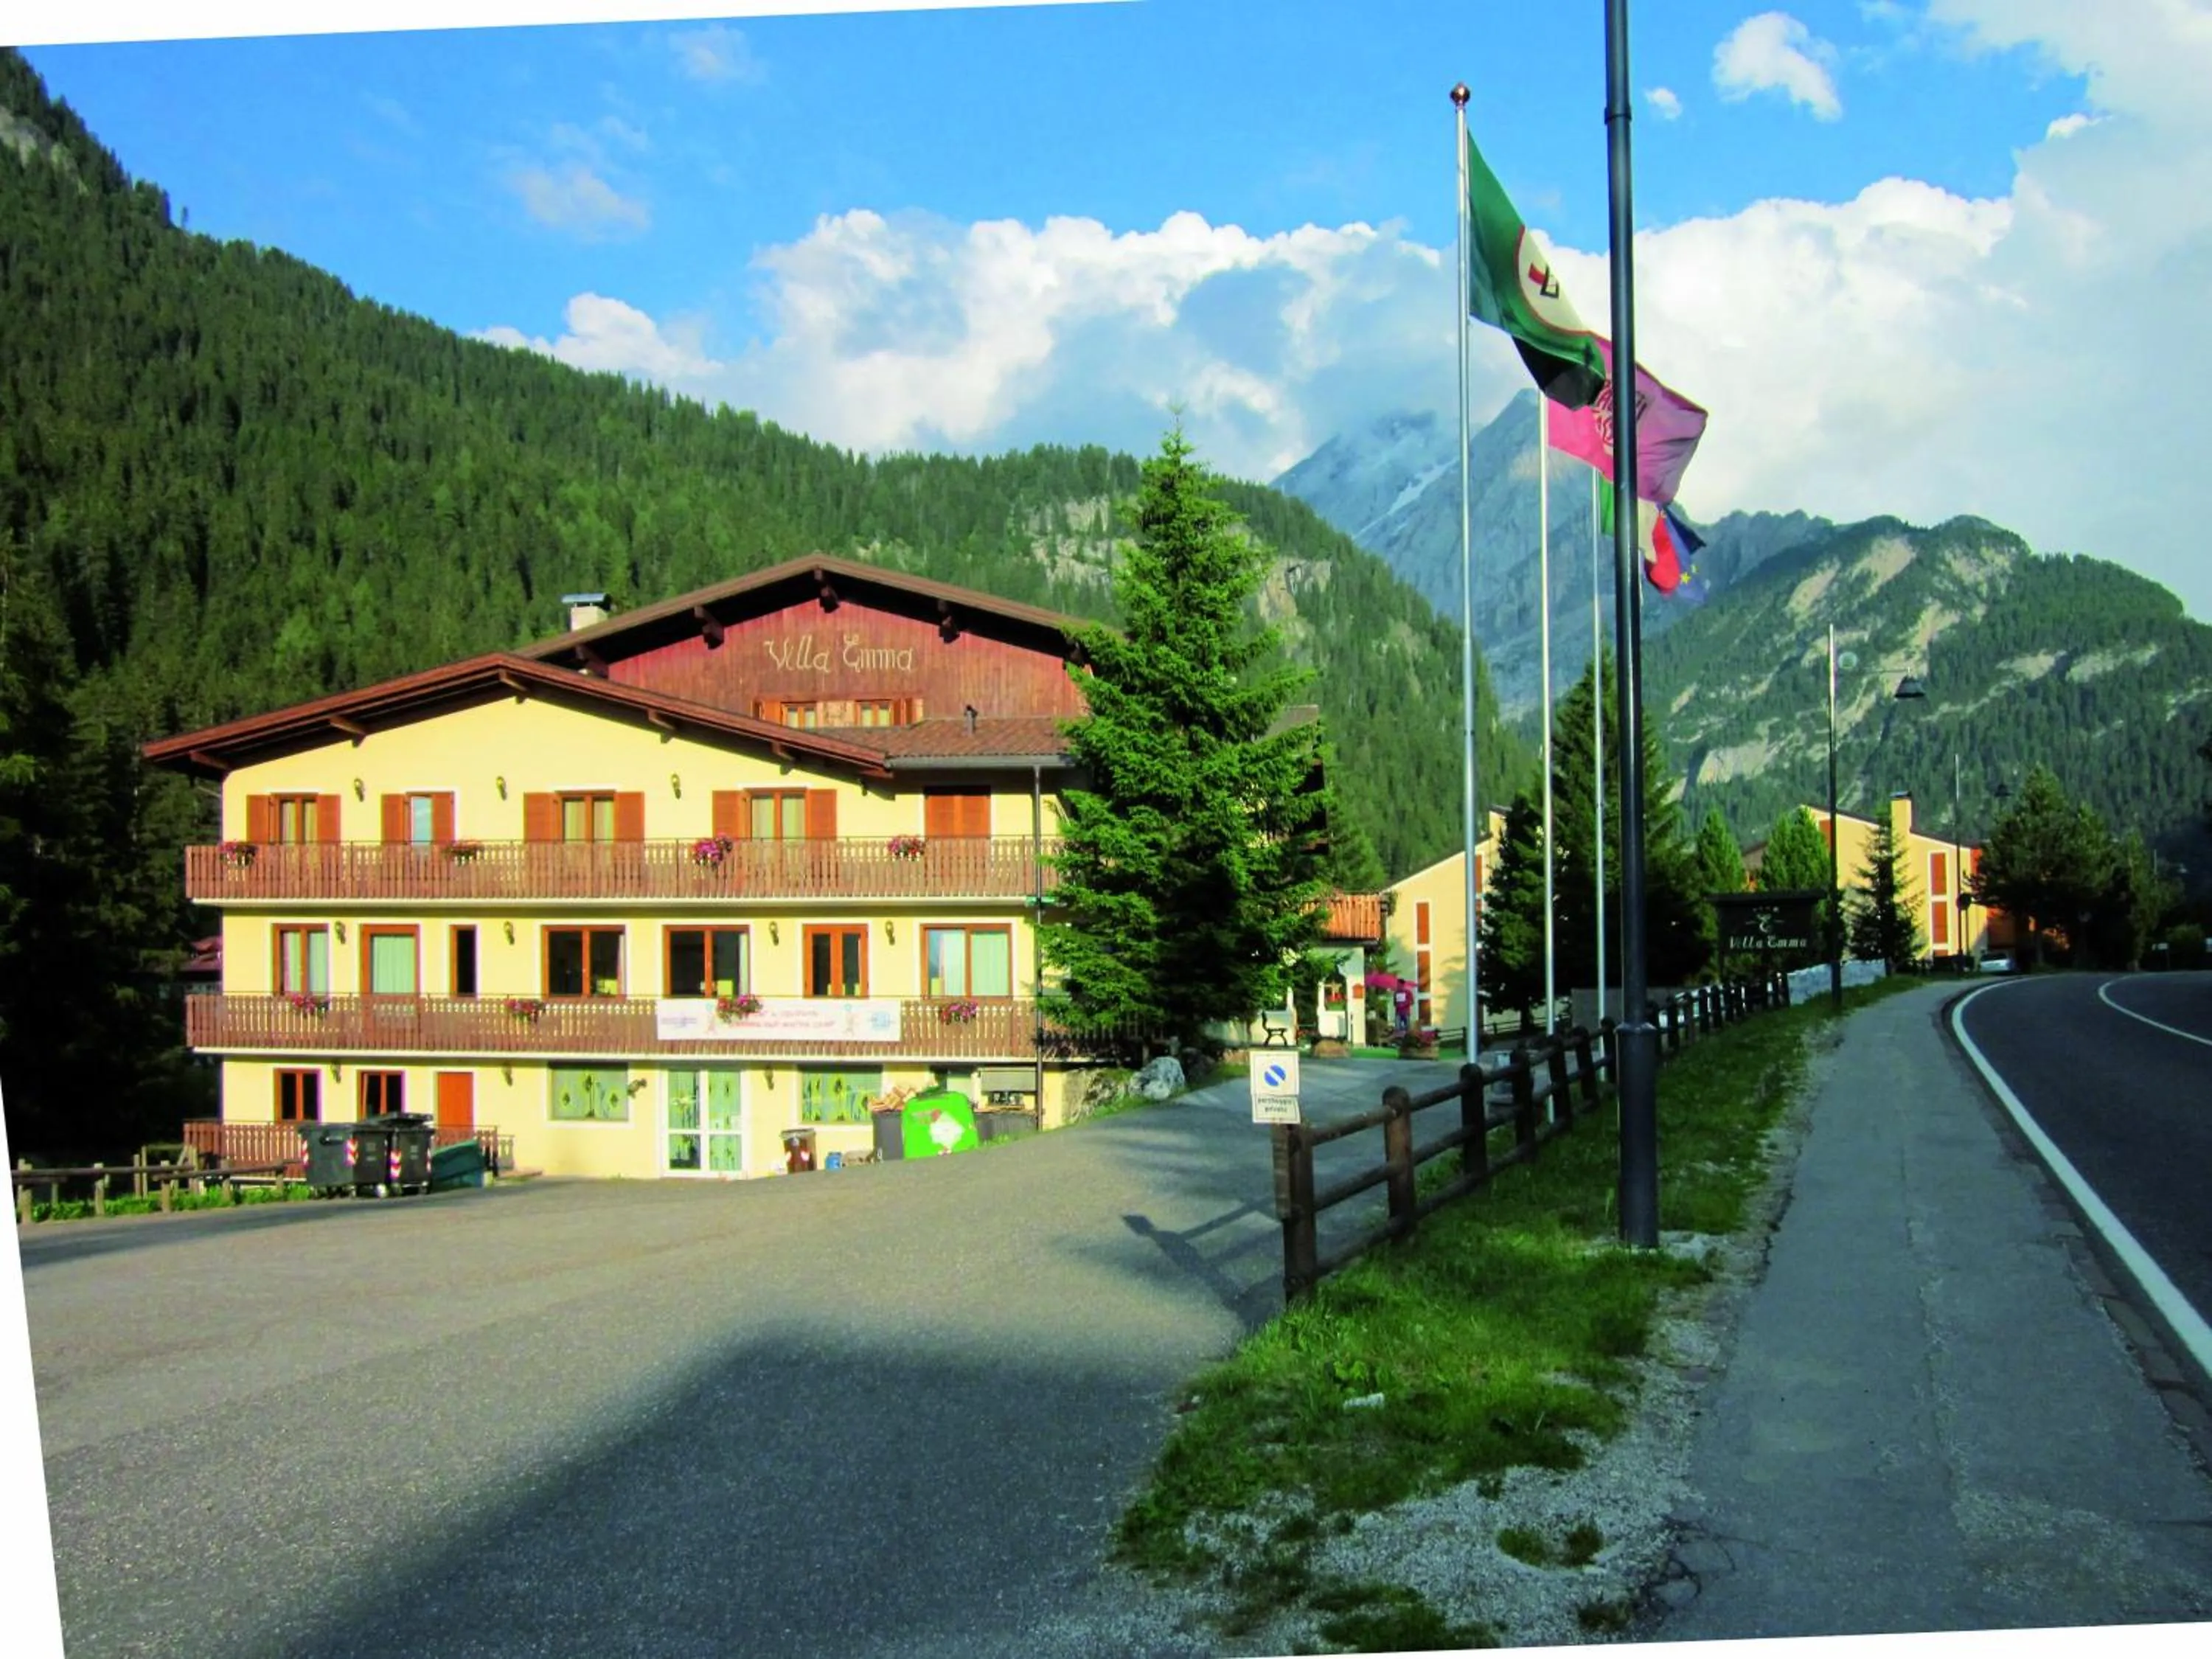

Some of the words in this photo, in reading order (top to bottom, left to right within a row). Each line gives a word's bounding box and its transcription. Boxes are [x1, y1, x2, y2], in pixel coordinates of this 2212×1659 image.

[764, 634, 830, 673] Villa
[842, 633, 913, 672] Emma
[1730, 936, 1763, 949] Villa
[1767, 935, 1806, 948] Emma
